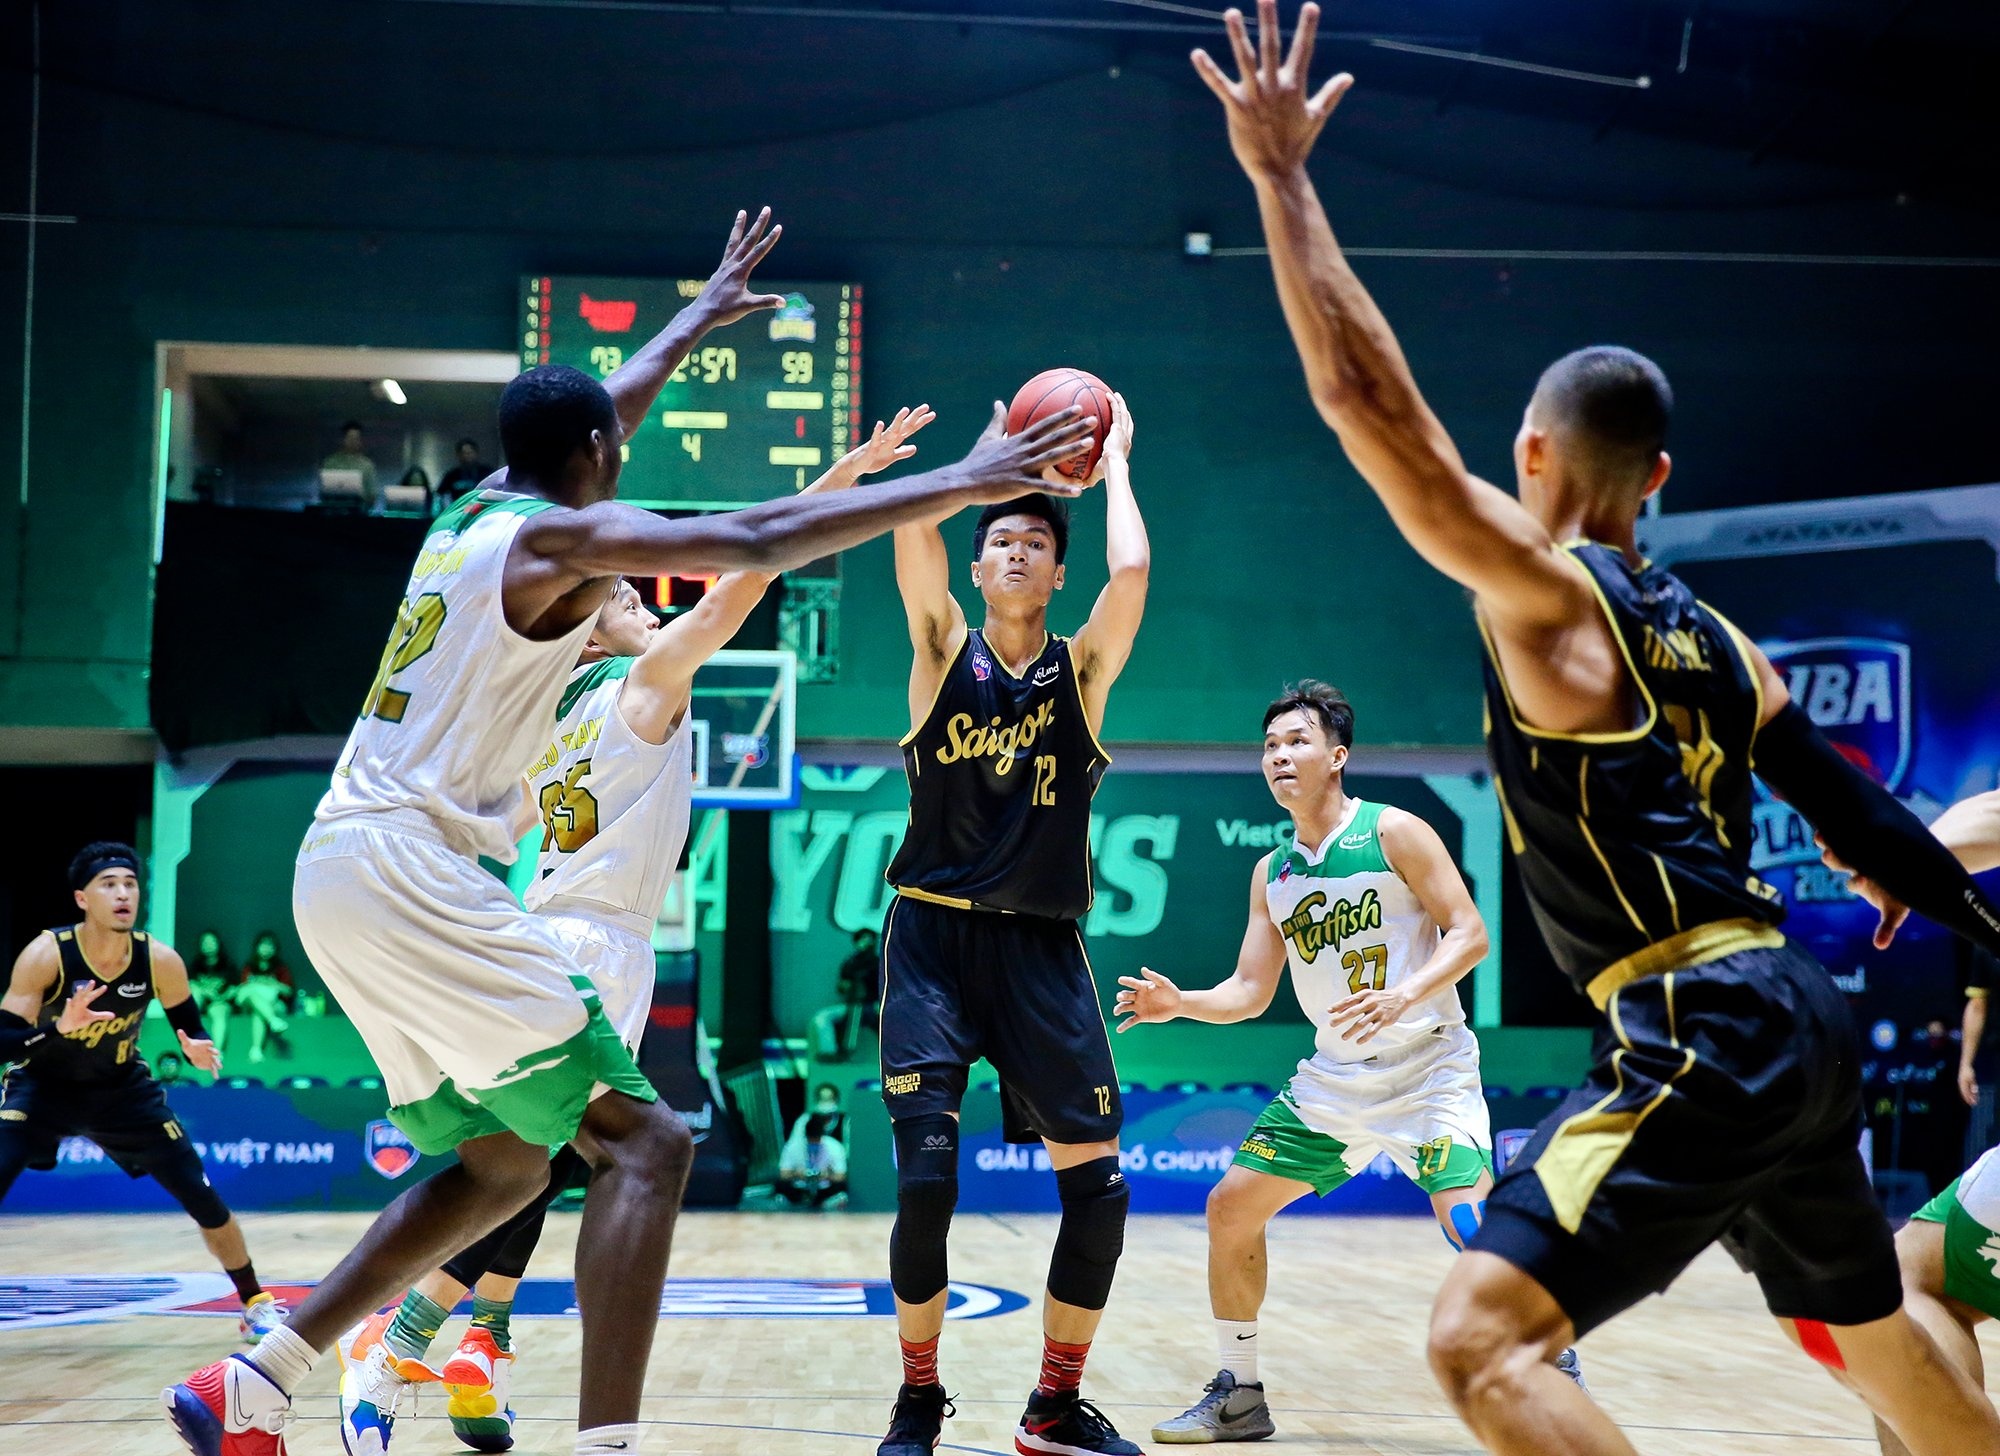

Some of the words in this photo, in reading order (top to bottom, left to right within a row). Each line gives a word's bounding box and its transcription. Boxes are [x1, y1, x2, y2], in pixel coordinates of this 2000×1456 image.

[681, 433, 702, 462] 4
[935, 697, 1056, 776] Saigon
[1292, 888, 1381, 964] Catfish
[1341, 944, 1388, 995] 27
[274, 1142, 334, 1164] NAM
[1421, 1135, 1452, 1177] 27
